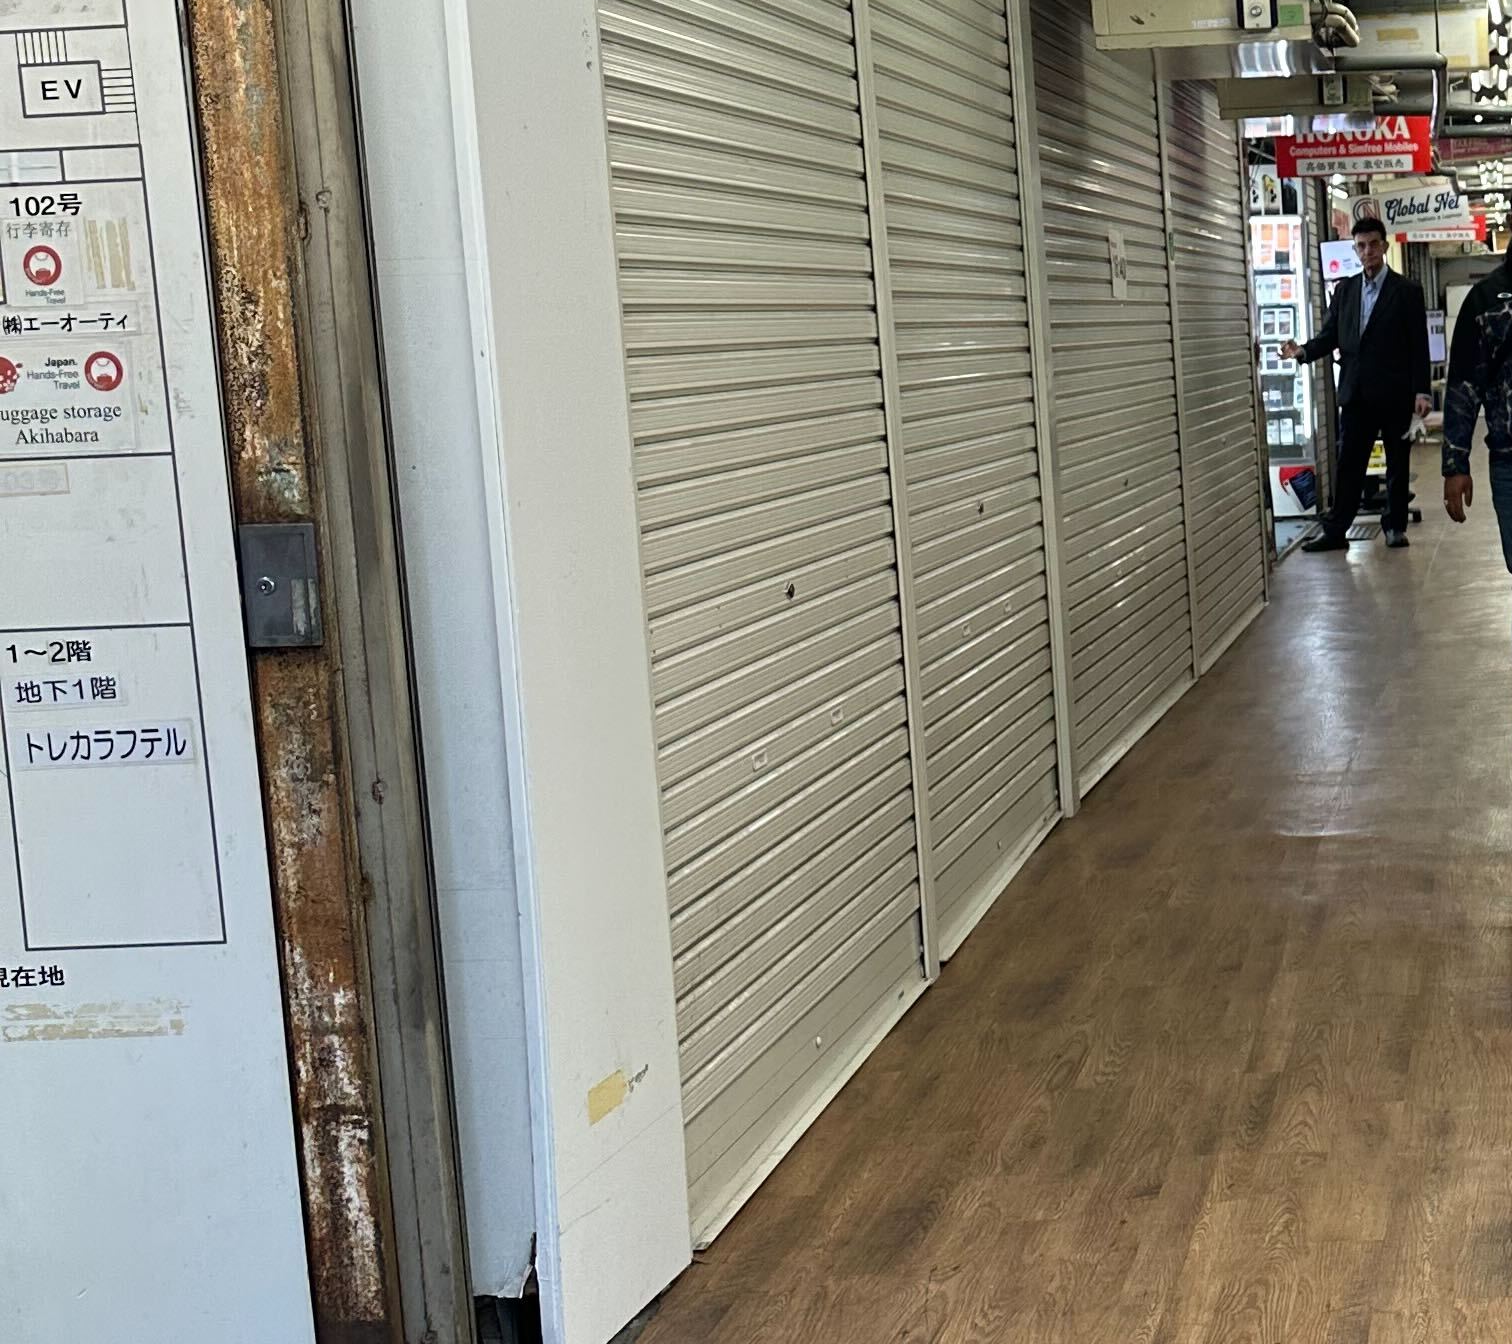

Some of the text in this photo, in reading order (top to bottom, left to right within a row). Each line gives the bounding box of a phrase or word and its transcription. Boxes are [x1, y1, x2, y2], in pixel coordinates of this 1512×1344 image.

[41, 79, 83, 101] EV
[9, 193, 82, 216] 102号
[1385, 194, 1430, 225] Global
[27, 369, 79, 380] Hands-Free
[53, 380, 81, 390] Travel
[63, 406, 122, 422] storage
[16, 427, 100, 445] Akihabara
[15, 677, 117, 704] 地下1階
[26, 727, 187, 764] トレカラフテル
